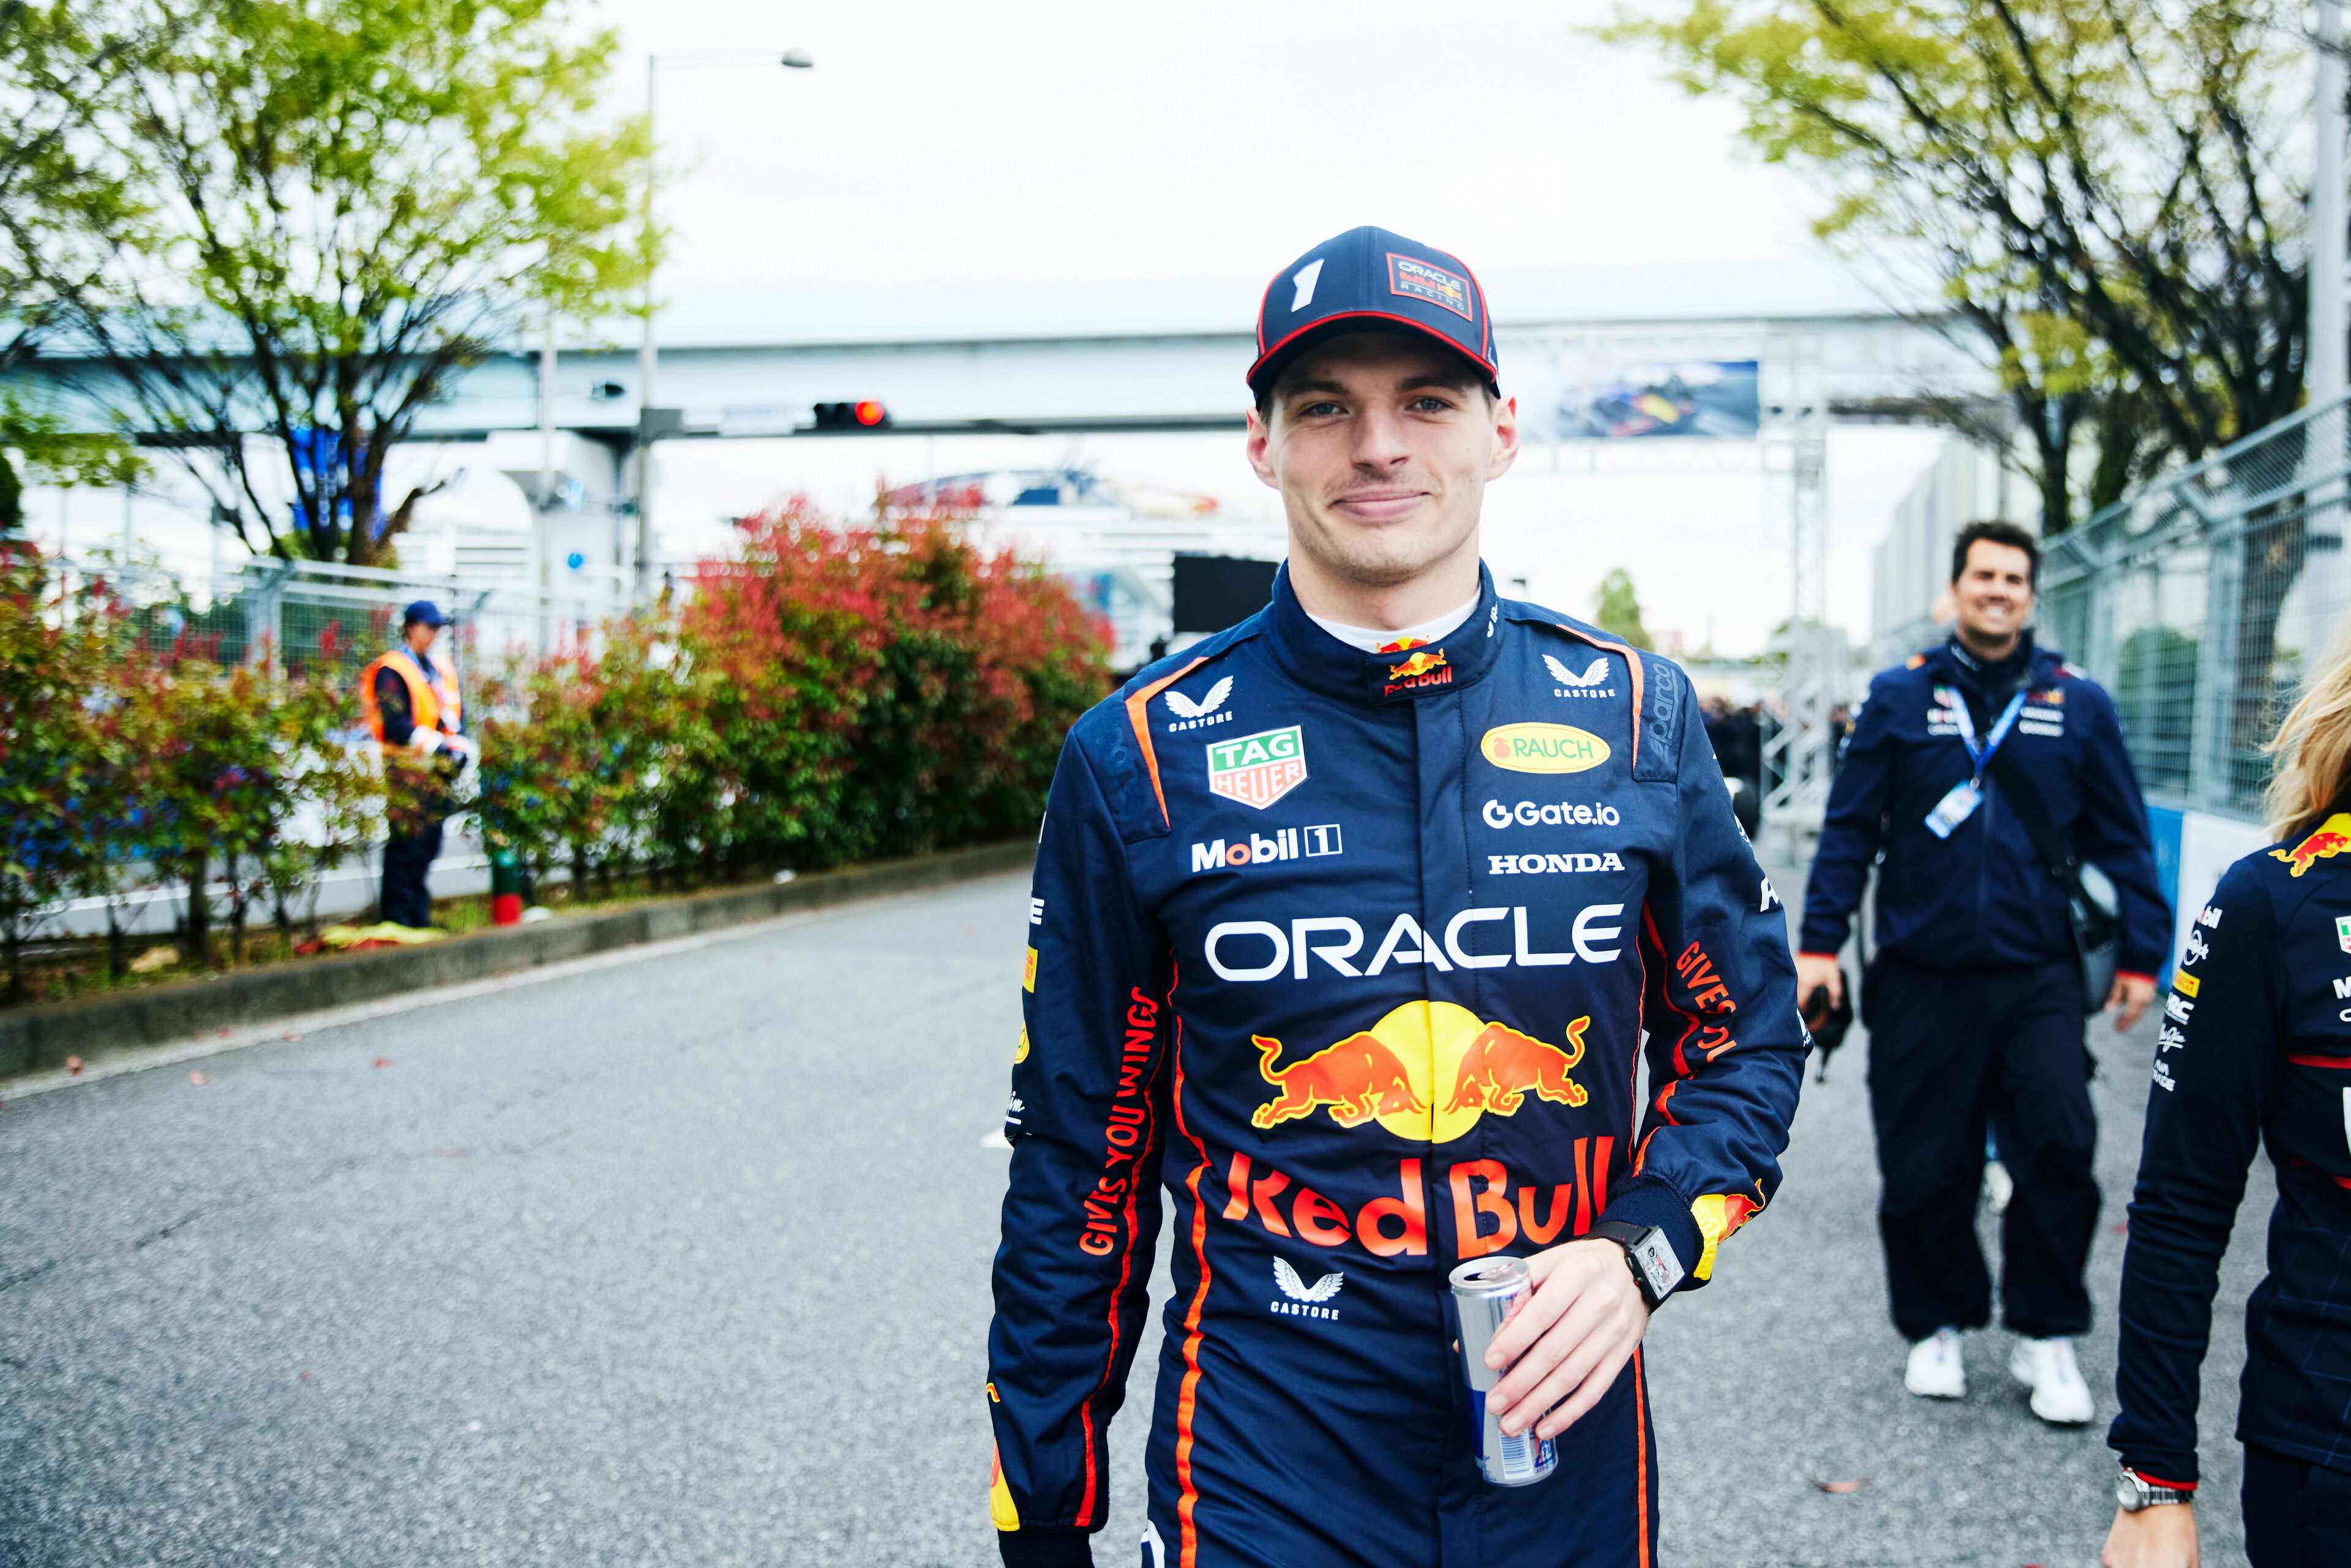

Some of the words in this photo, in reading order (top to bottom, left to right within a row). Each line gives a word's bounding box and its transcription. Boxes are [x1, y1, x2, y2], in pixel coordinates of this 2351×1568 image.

[1291, 258, 1324, 313] 1
[1398, 260, 1461, 291] ORACLE
[1400, 283, 1464, 311] RACING
[1418, 666, 1452, 687] Bull
[1554, 688, 1616, 699] CASTORE
[1169, 711, 1233, 732] CASTORE
[1649, 663, 1675, 757] sparco
[1216, 733, 1295, 768] TAG
[1513, 738, 1594, 759] RAUCH
[1217, 762, 1300, 803] HEUER
[1514, 801, 1620, 827] Gate.io
[1191, 828, 1299, 872] Mobil
[1488, 853, 1625, 875] HONDA
[1204, 903, 1625, 981] ORACLE
[1676, 940, 1737, 1015] GIVES
[1116, 986, 1158, 1098] WINGS
[1105, 1105, 1146, 1169] YOU
[1223, 1152, 1428, 1258] Red
[1448, 1136, 1614, 1259] Bull
[1270, 1301, 1339, 1321] CASTORE
